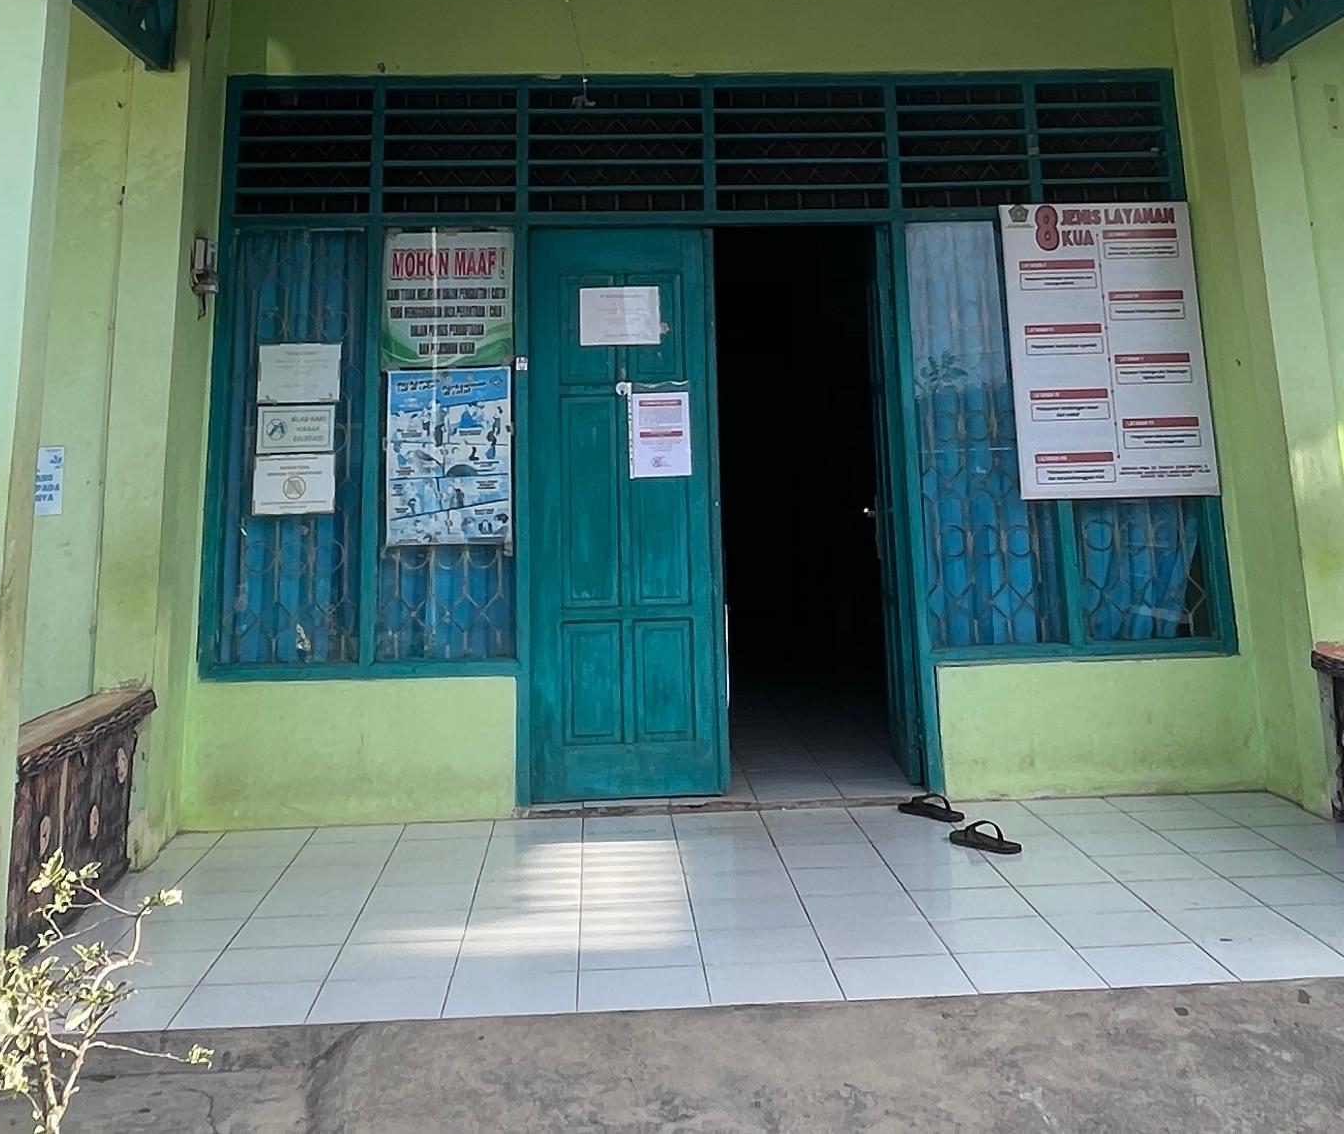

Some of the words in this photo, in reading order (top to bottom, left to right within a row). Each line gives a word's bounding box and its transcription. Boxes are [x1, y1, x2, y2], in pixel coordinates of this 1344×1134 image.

[1035, 205, 1060, 251] 8
[1061, 209, 1101, 226] JENIS
[1103, 207, 1175, 224] LAYANAN
[1063, 230, 1094, 246] KUA
[392, 249, 449, 280] MOHON
[454, 248, 496, 279] MAAF
